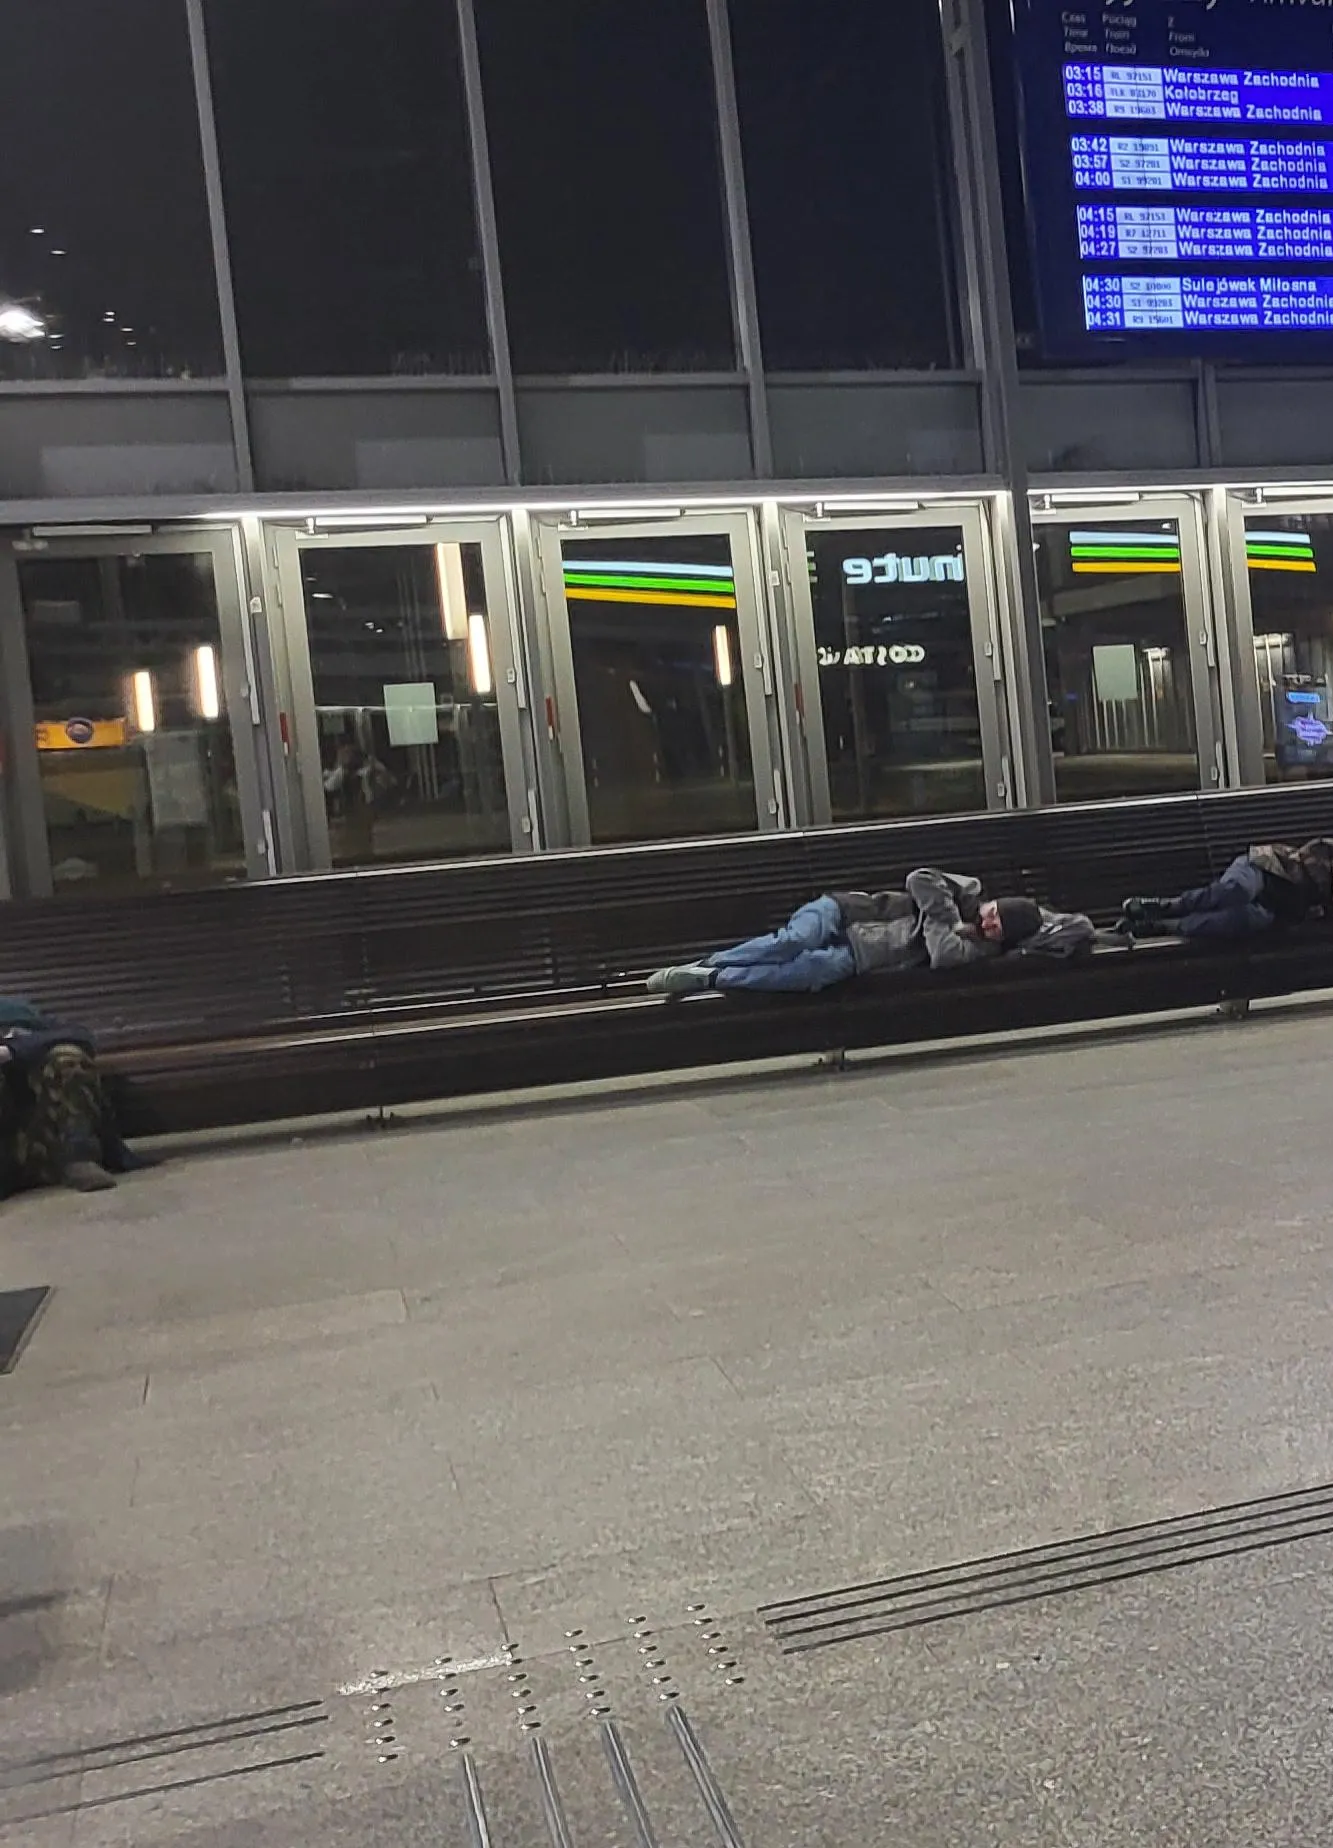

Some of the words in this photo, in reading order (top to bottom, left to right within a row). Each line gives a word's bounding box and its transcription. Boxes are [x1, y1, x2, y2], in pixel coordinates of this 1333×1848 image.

[1066, 66, 1100, 80] 03:15
[1164, 69, 1239, 85] Warszawa
[1244, 71, 1319, 87] Zachodnia
[1067, 84, 1102, 98] 03:16
[1164, 86, 1239, 103] Kołobrzeg
[1068, 100, 1104, 114] 03:38
[1167, 102, 1241, 118] Warszawa
[1246, 104, 1322, 120] Zachodnia
[1072, 138, 1108, 152] 03:42
[1170, 138, 1244, 154] Warszawa
[1250, 141, 1325, 156] Zachodnia
[1074, 155, 1107, 169] 03:57
[1171, 155, 1245, 171] Warszawa
[1251, 157, 1326, 172] Zachodnia
[1075, 172, 1110, 186] 04:00
[1172, 173, 1247, 188] Warszawa
[1252, 174, 1328, 189] Zachodnia
[1080, 208, 1114, 222] 04:15
[1176, 208, 1249, 223] Warszawa
[1256, 209, 1330, 224] Zachodnia
[1081, 225, 1116, 239] 04:19
[1177, 225, 1251, 240] Warszawa
[1257, 226, 1332, 240] Zachodnia
[1082, 242, 1116, 256] 04:27
[1179, 242, 1252, 257] Warszawa
[1258, 242, 1333, 257] Zachodnia
[1182, 278, 1255, 294] Sulejówek
[1260, 278, 1316, 292] Miłosna
[1183, 295, 1257, 309] Warszawa
[1088, 311, 1120, 326] 04:31
[1184, 311, 1258, 326] Warszawa
